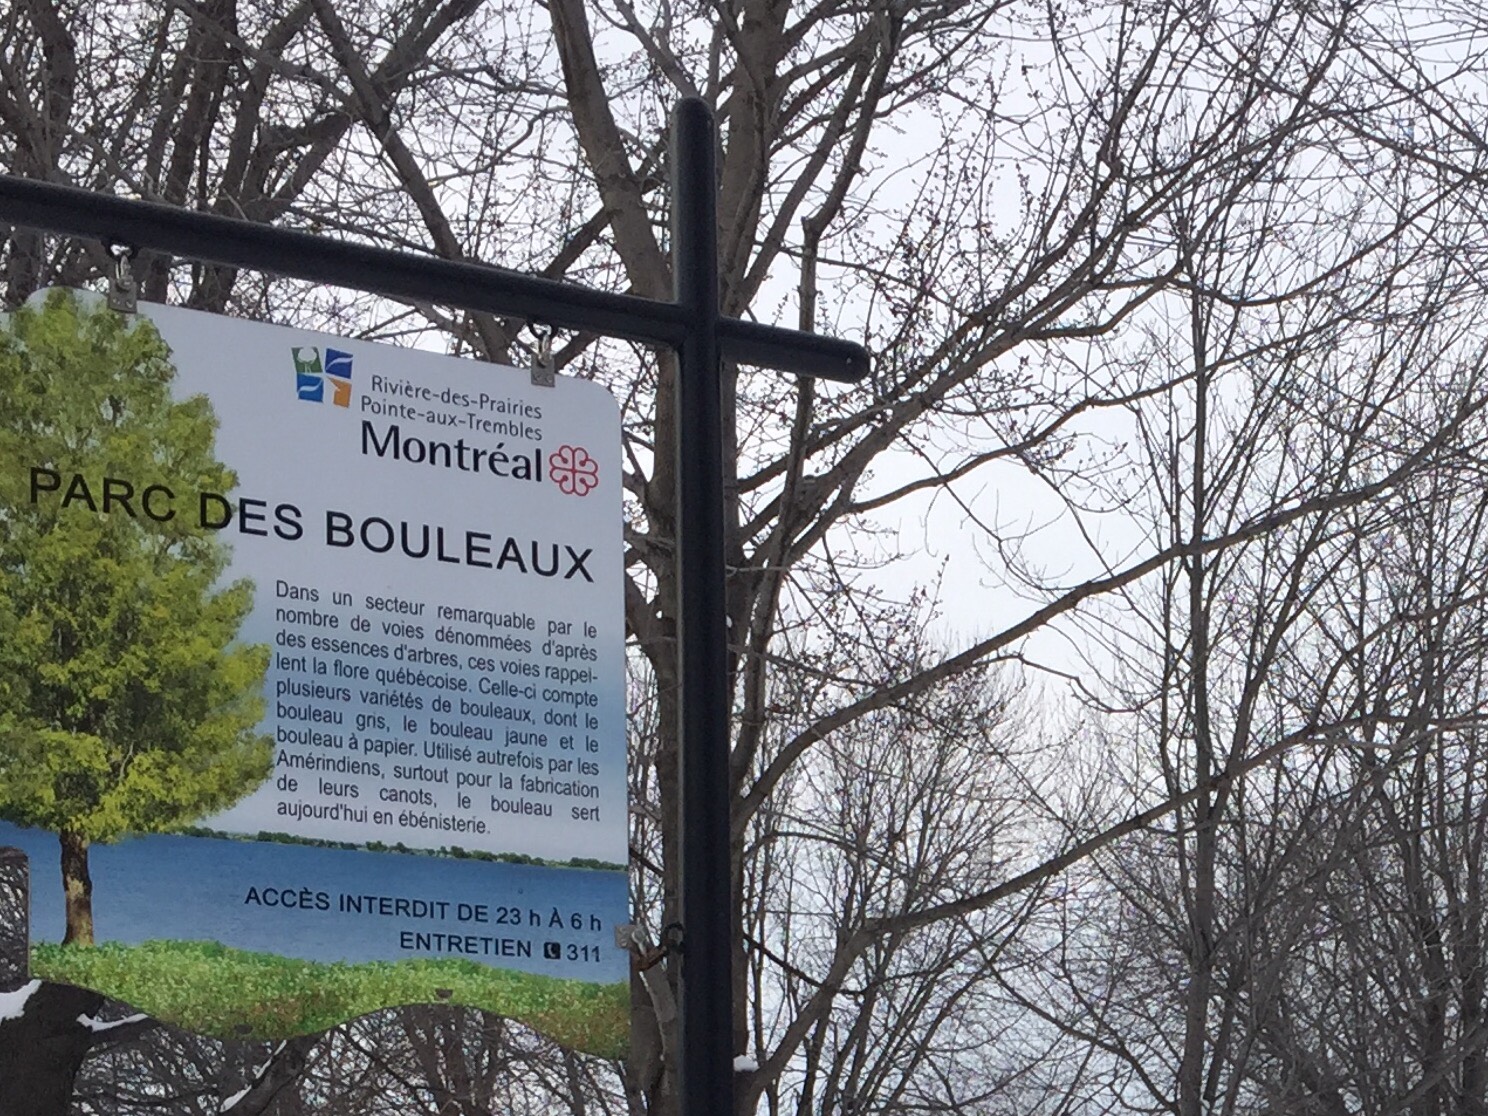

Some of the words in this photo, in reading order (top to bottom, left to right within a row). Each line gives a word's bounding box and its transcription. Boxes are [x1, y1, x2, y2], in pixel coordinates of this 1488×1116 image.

[360, 395, 543, 441] Pointe-aux-Trembles
[371, 374, 543, 420] Rivière-des-Prairies
[361, 419, 542, 482] Montréal
[30, 467, 175, 522] PARC
[200, 493, 303, 541] DES
[326, 511, 595, 583] BOULEAUX
[276, 579, 320, 602] Dans
[332, 591, 352, 606] un
[365, 596, 425, 616] secteur
[437, 605, 536, 631] remarquable
[547, 620, 573, 637] par
[584, 621, 598, 639] le
[276, 608, 339, 629] nombre
[350, 614, 371, 632] de
[382, 620, 424, 640] voies
[435, 625, 532, 653] dénommées
[542, 639, 598, 662] d'après
[276, 628, 306, 649] des
[311, 636, 389, 659] essences
[394, 643, 463, 670] d'arbres,
[468, 656, 496, 672] ces
[500, 659, 541, 677] voies
[276, 652, 307, 672] lent
[313, 656, 327, 675] la
[333, 658, 370, 680] flore
[375, 666, 472, 693] québécoise.
[478, 676, 536, 700] Celle-ci
[542, 687, 599, 709] compte
[276, 678, 351, 702] plusieurs
[360, 688, 424, 710] variétés
[432, 695, 452, 713] de
[460, 698, 536, 726] bouleaux,
[544, 709, 578, 728] dont
[585, 712, 599, 730] le
[276, 701, 343, 725] bouleau
[356, 712, 391, 733] gris,
[403, 715, 418, 733] le
[430, 718, 493, 742] bouleau
[504, 726, 548, 748] jaune
[559, 735, 575, 751] et
[585, 735, 599, 753] le
[276, 725, 343, 749] bouleau
[349, 732, 359, 750] à
[363, 737, 418, 758] papier.
[423, 740, 472, 763] Utilisé
[476, 750, 544, 771] autrefois
[548, 757, 573, 775] par
[577, 757, 600, 776] les
[276, 749, 386, 780] Amérindiens,
[393, 765, 449, 784] surtout
[456, 771, 493, 789] pour
[499, 772, 513, 790] la
[520, 773, 600, 798] fabrication
[276, 774, 298, 793] de
[319, 777, 360, 799] leurs
[379, 787, 438, 809] canots,
[457, 792, 471, 810] le
[491, 795, 553, 817] bouleau
[571, 805, 600, 822] sert
[277, 799, 368, 823] aujourd'hui
[373, 810, 393, 825] en
[398, 809, 491, 834] ébénisterie.
[243, 885, 331, 912] ACCÈS
[339, 893, 450, 921] INTERDIT
[457, 902, 489, 923] DE
[496, 906, 522, 926] 23
[528, 908, 541, 928] h
[548, 906, 565, 929] À
[570, 912, 583, 931] 6
[589, 912, 601, 931] h
[400, 931, 532, 959] ENTRETIEN
[566, 943, 601, 963] 311
